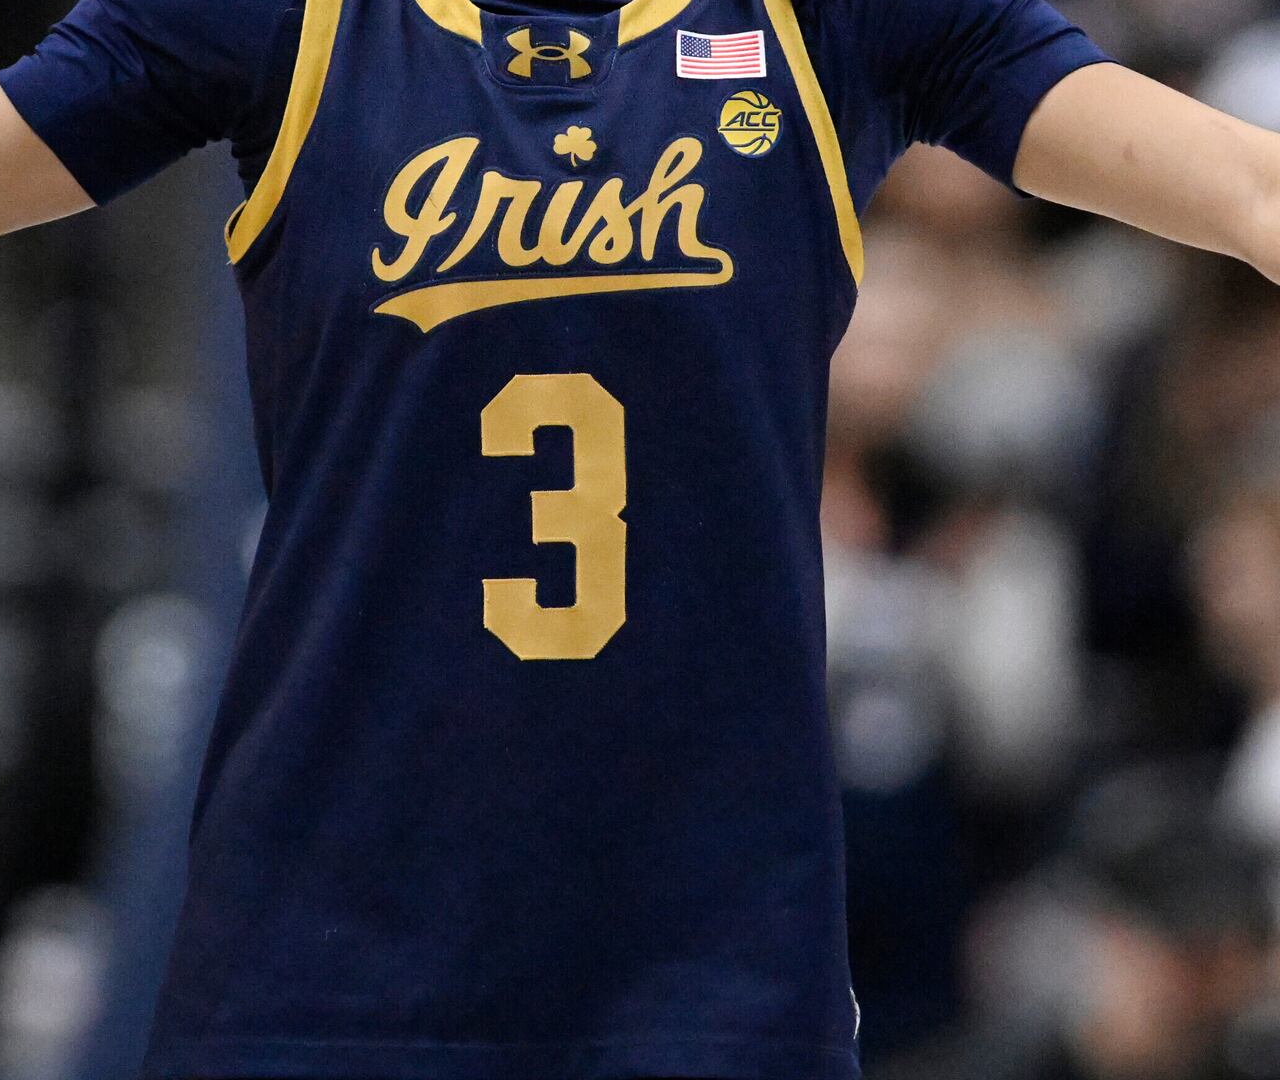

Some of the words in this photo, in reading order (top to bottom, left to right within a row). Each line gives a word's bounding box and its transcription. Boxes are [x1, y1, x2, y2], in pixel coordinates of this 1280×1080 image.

[725, 110, 781, 127] ACC
[371, 136, 734, 285] Irish
[480, 373, 627, 660] 3
